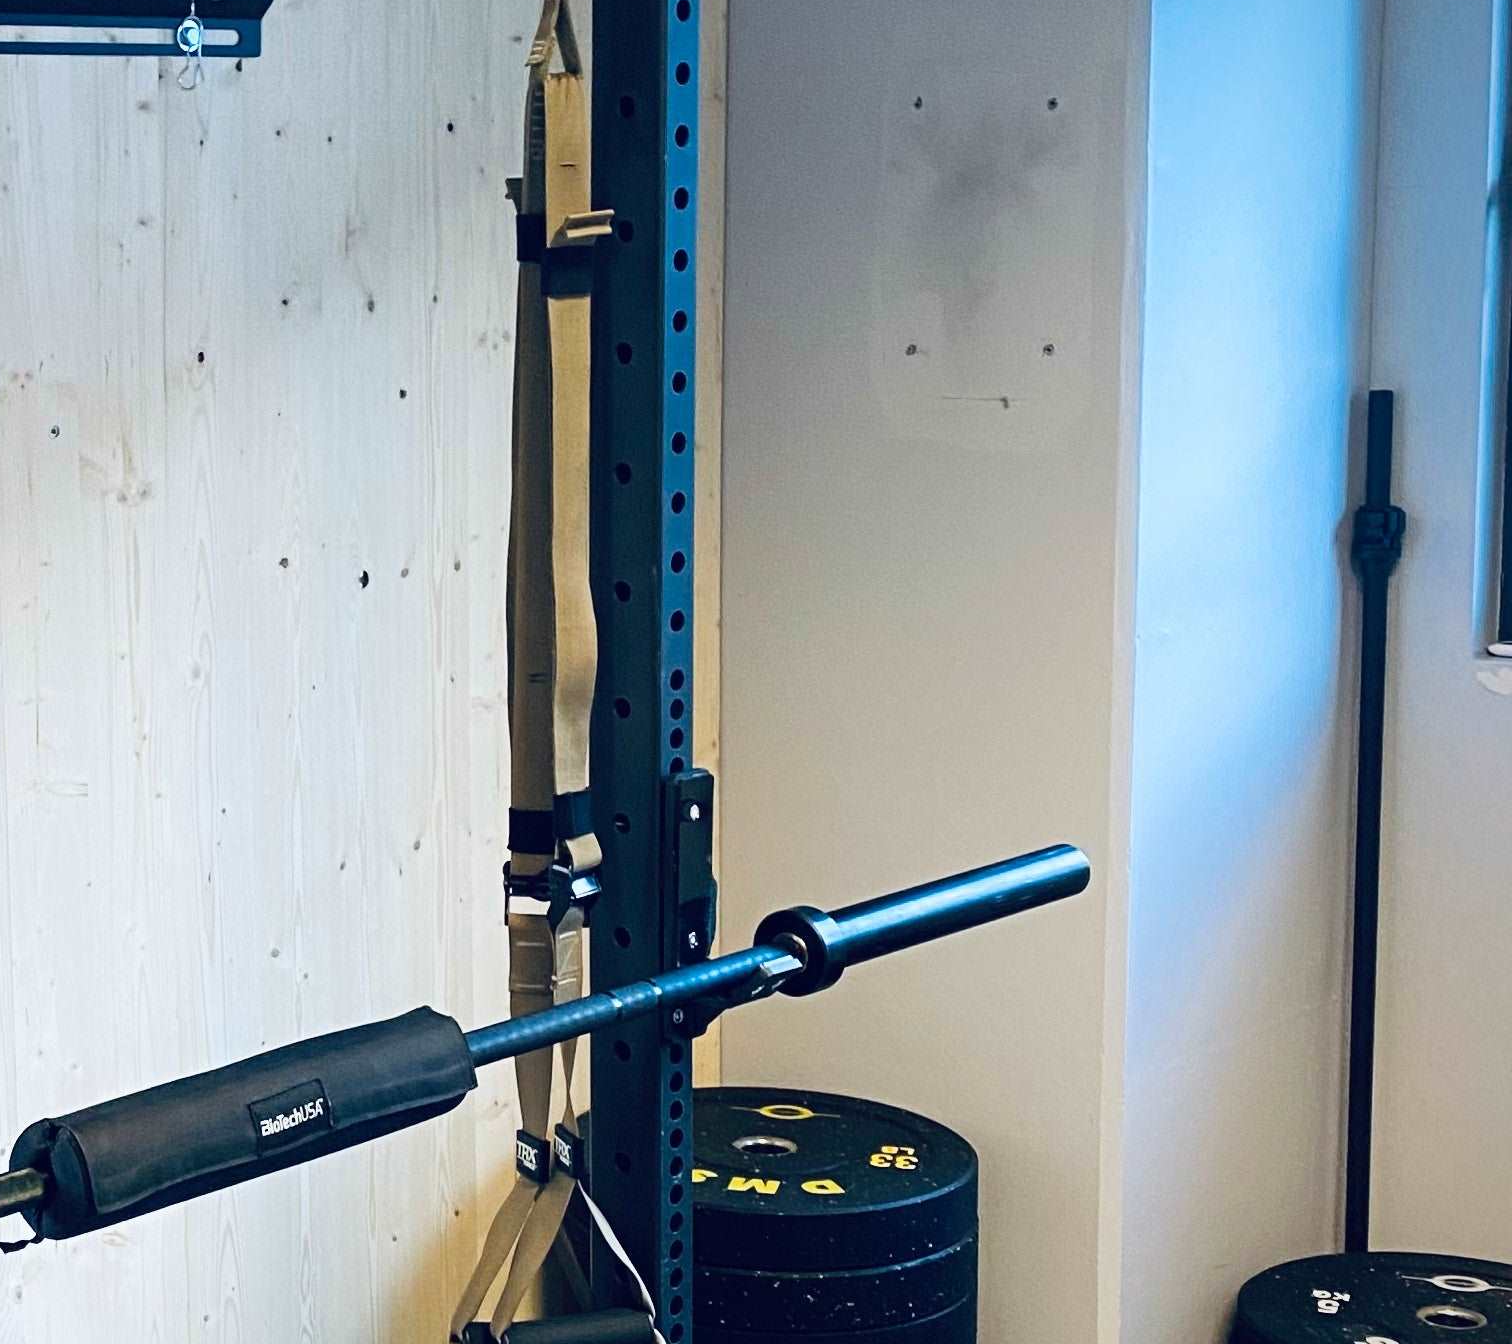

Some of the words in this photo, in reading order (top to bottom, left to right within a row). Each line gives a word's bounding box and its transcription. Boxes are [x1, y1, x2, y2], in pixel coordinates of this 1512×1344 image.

[260, 1098, 324, 1136] BioTechUSA
[517, 1141, 538, 1164] TRX
[555, 1135, 572, 1162] TRX
[869, 1153, 919, 1170] 33
[1317, 1299, 1340, 1314] 5
